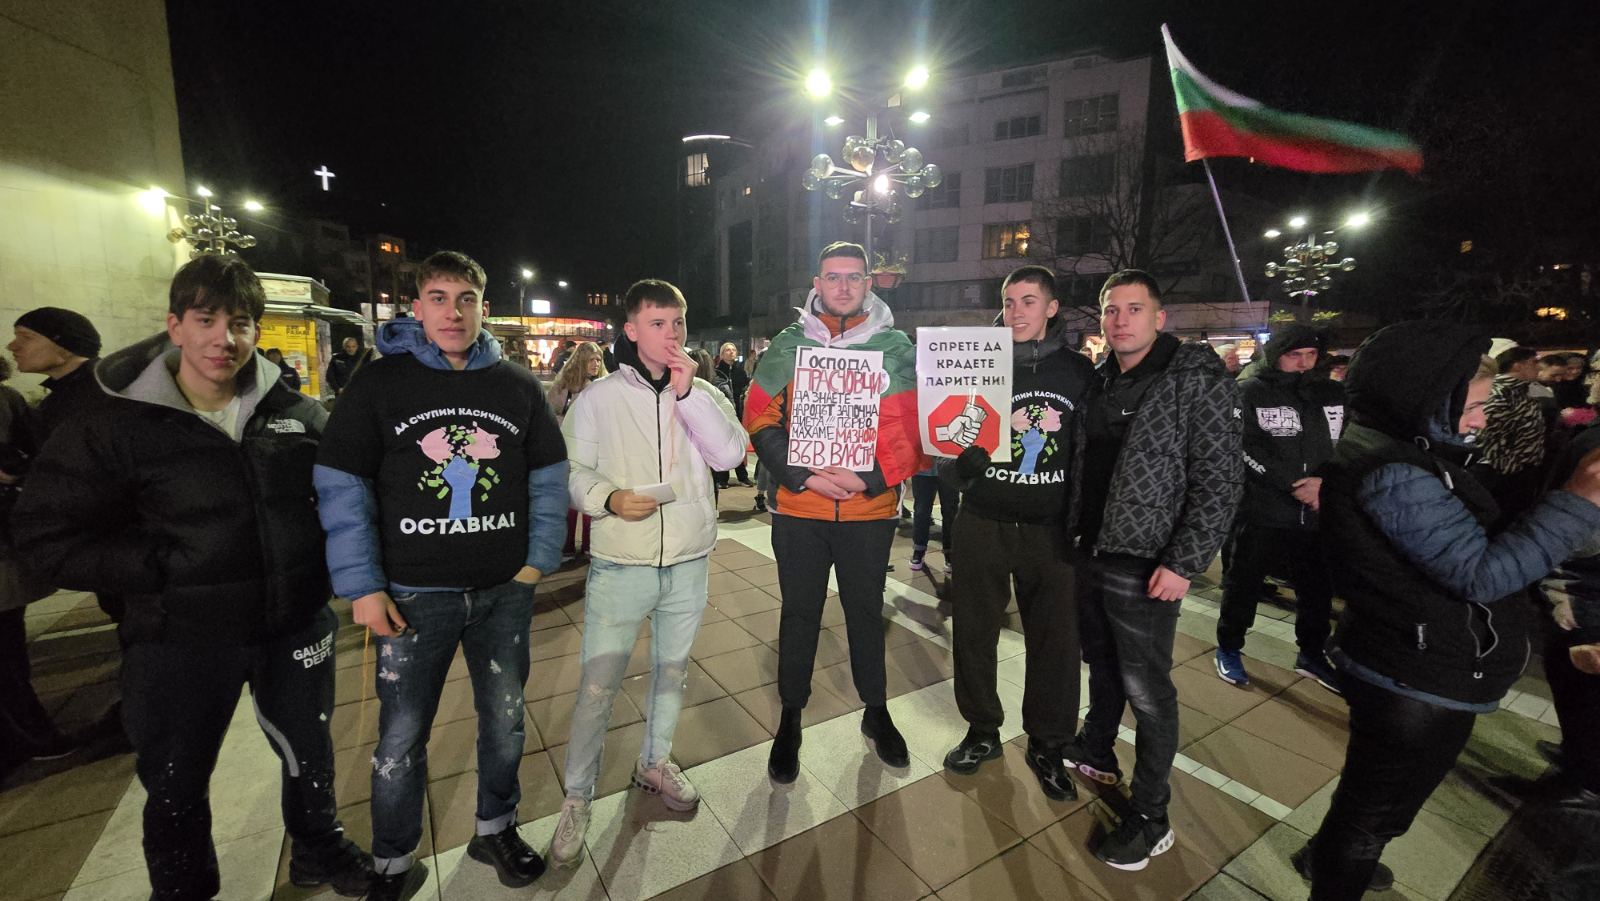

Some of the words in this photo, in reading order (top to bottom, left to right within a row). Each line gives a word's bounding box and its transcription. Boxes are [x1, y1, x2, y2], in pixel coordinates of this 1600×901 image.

[928, 341, 980, 352] СПРЕТЕ
[983, 341, 1002, 352] ДА
[798, 347, 871, 372] ГОСПОДА
[936, 358, 995, 370] КРАДЕТЕ
[926, 376, 978, 387] ПАРИТЕ
[982, 375, 1006, 386] НИ!
[794, 390, 810, 403] ДА
[812, 391, 851, 405] ЗНАЕТЕ
[792, 403, 836, 418] НАРОДЪТ
[837, 403, 880, 418] ЗАПОЧНА
[394, 421, 410, 436] ДА
[409, 407, 456, 425] СЧУПИМ
[458, 407, 520, 436] КАСИЧКИТЕ!
[837, 416, 873, 430] ПЪРВО
[791, 425, 835, 440] МАХАМЕ
[789, 438, 826, 467] ВЪВ
[985, 465, 1065, 485] ОСТАВКА!
[400, 511, 516, 535] ОСТАВКА!
